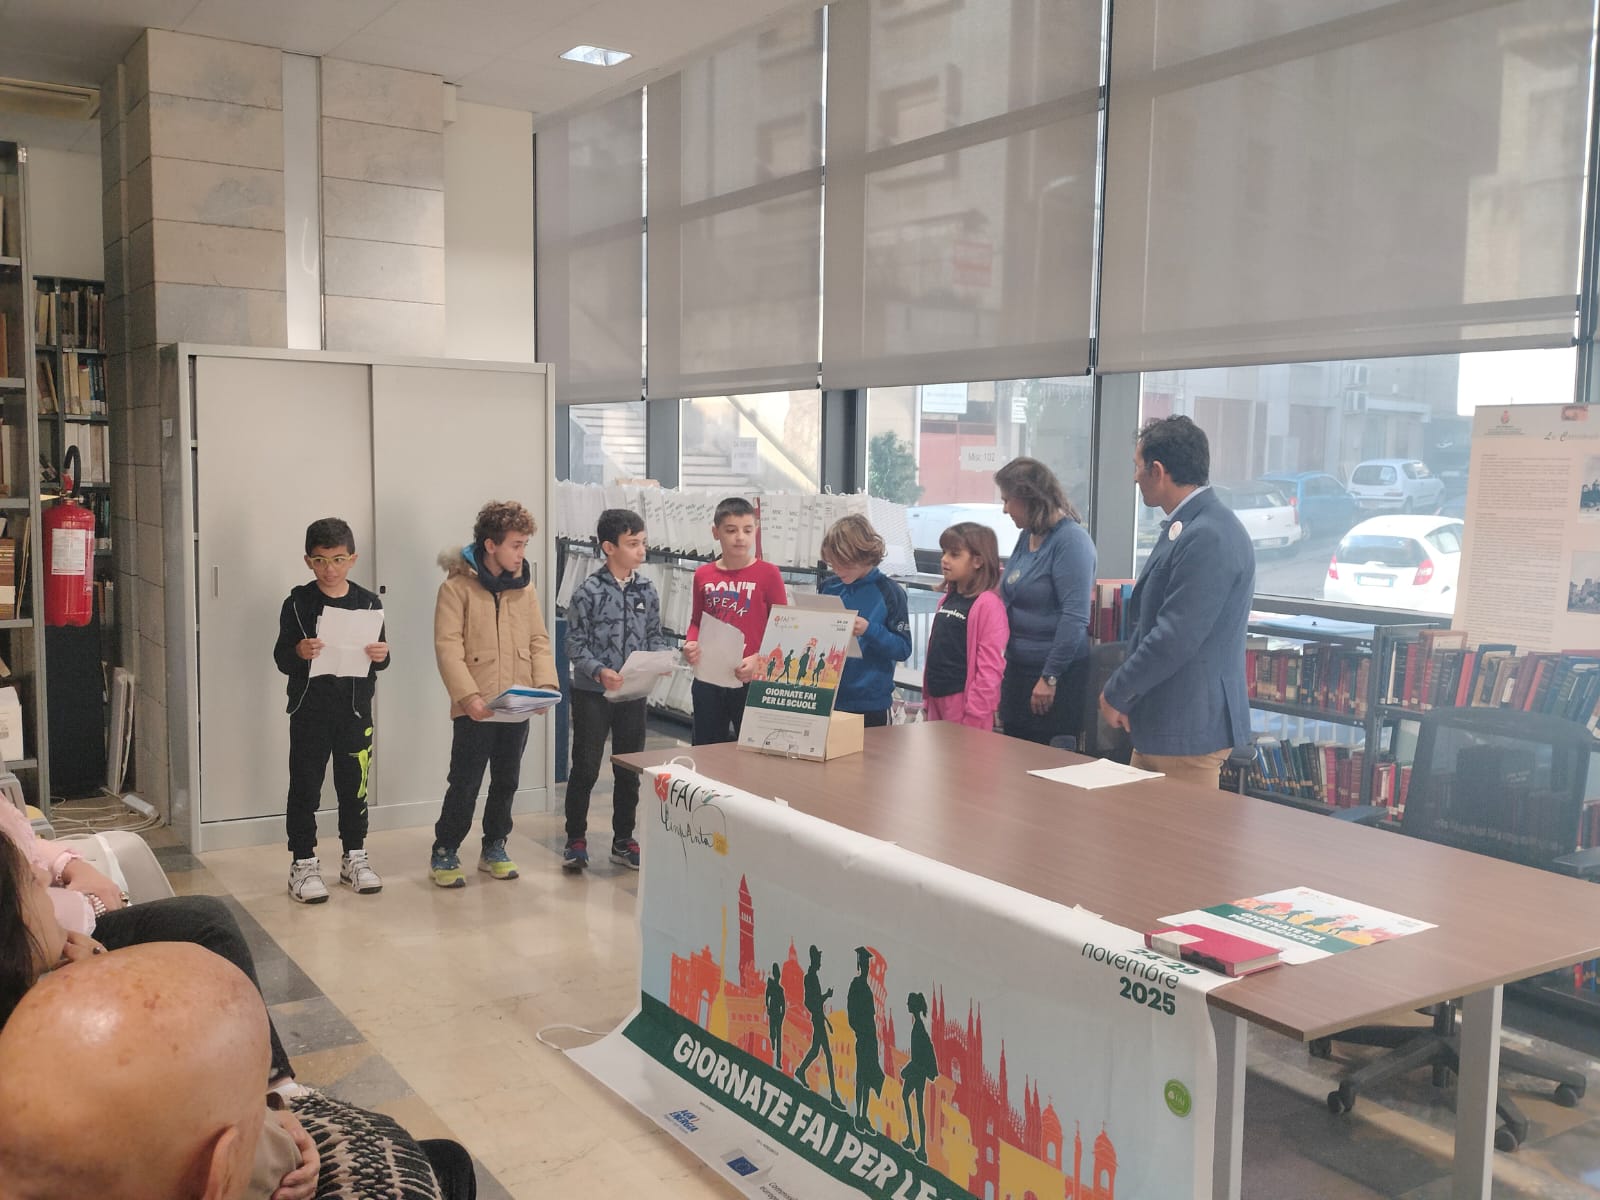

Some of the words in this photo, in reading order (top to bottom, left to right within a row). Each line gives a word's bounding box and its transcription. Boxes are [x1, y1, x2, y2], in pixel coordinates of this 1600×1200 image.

[706, 597, 748, 617] SPEAK
[761, 695, 777, 705] PER
[776, 698, 786, 706] LE
[786, 699, 817, 710] SCUOLE
[765, 687, 804, 700] GIORNATE
[804, 692, 817, 701] FAI
[671, 778, 702, 813] FAI
[1081, 942, 1179, 990] novembre
[1119, 976, 1176, 1016] 2025
[673, 1033, 793, 1128] GIORNATE
[788, 1102, 839, 1157] FAI
[833, 1131, 899, 1190] PER
